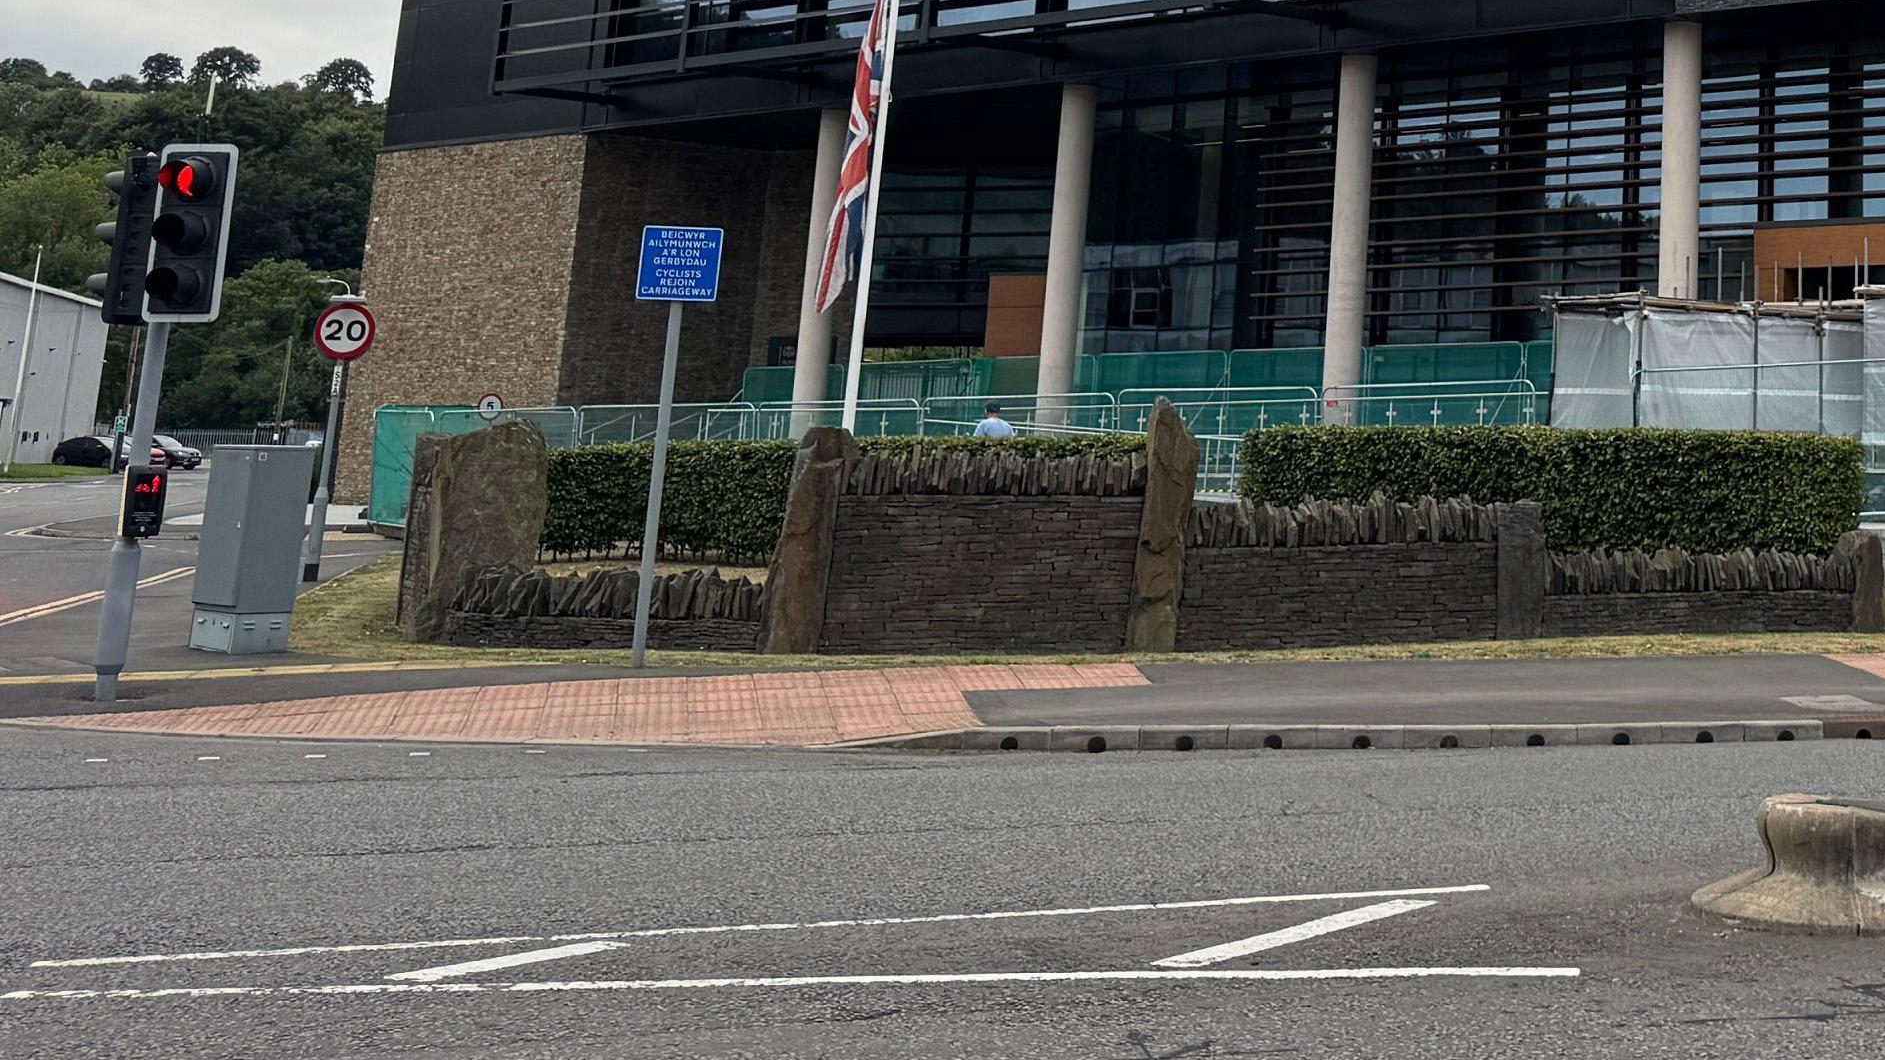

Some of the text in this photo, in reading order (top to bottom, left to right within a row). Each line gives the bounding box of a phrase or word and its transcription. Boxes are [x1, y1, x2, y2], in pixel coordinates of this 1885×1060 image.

[661, 230, 706, 240] BEICWYR
[648, 239, 716, 249] AILYMUNWCH
[653, 257, 707, 266] GERBYDAU
[655, 268, 702, 278] CYCLISTS
[660, 278, 696, 286] REJOIN
[641, 286, 712, 296] CARRIAGEWAY
[324, 319, 366, 341] 20
[487, 401, 495, 410] 5
